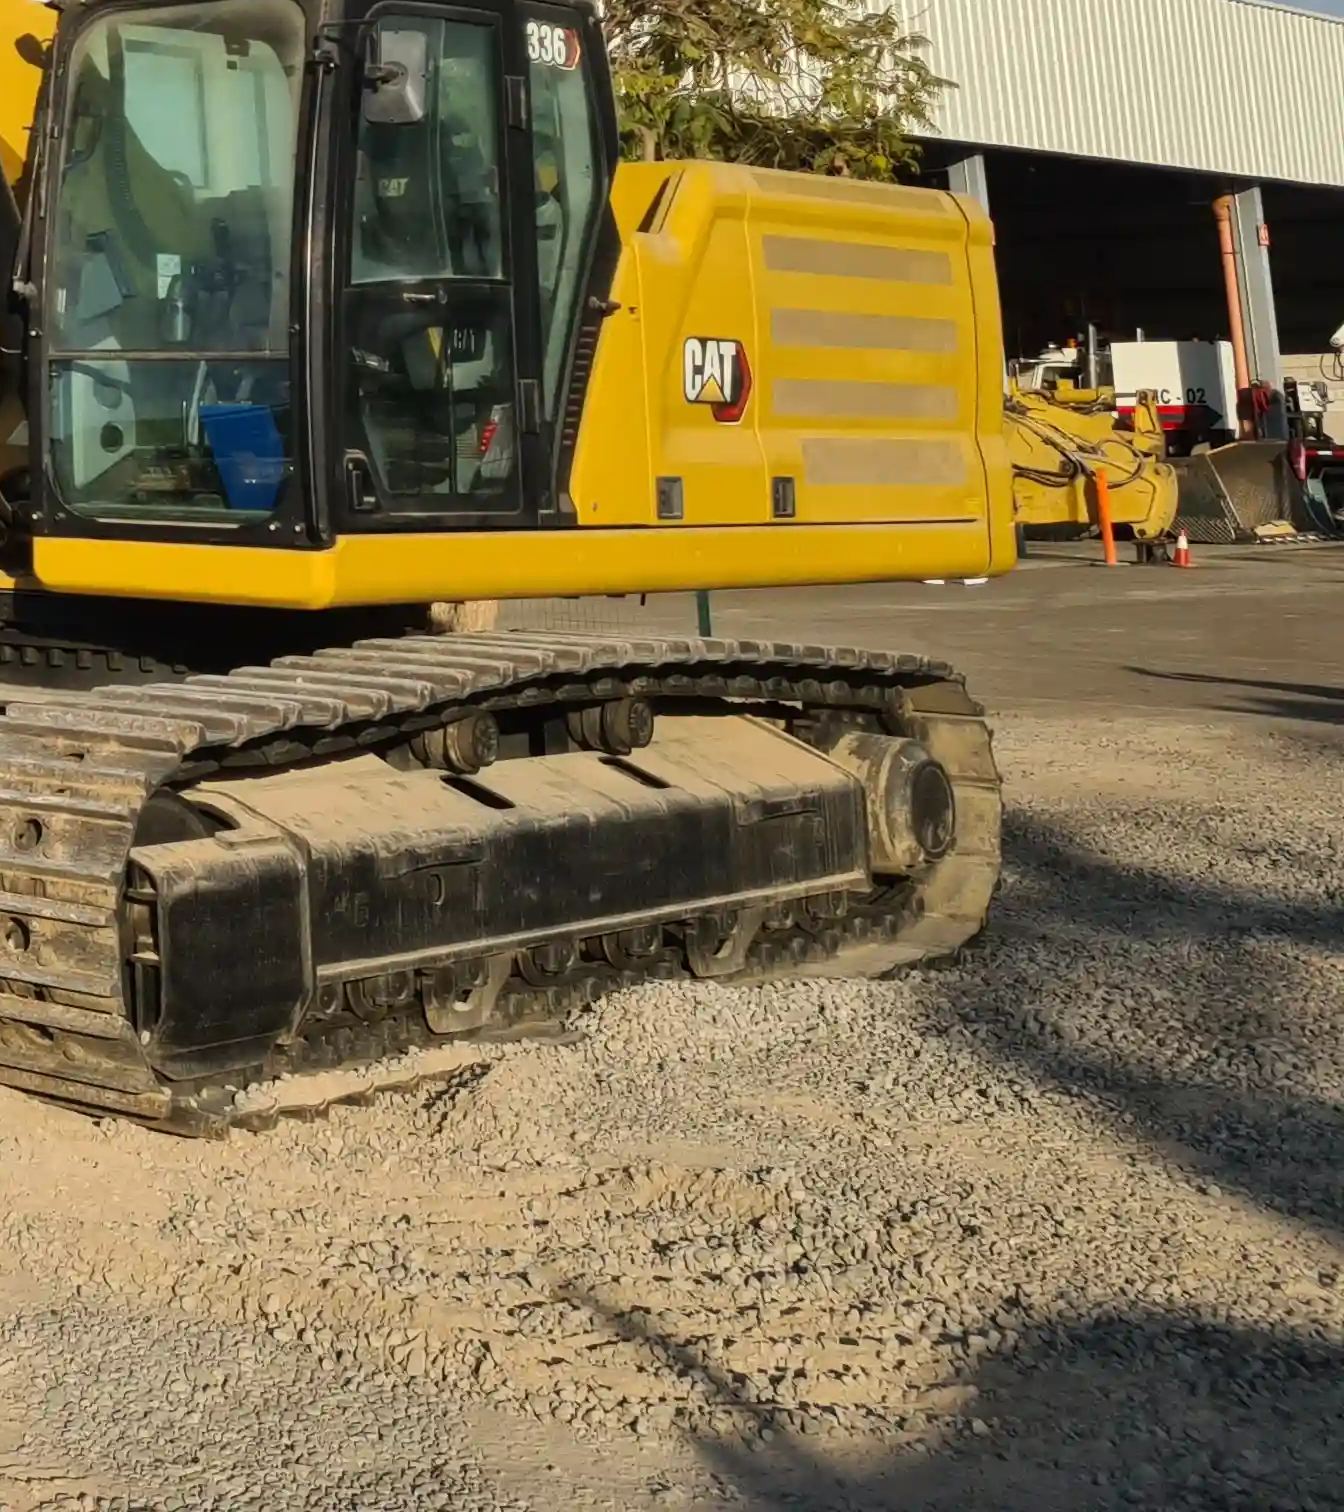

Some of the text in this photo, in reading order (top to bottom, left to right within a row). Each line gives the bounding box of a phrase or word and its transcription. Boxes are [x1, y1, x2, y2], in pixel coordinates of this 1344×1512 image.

[526, 21, 567, 66] 336
[378, 178, 410, 197] CAT
[684, 338, 737, 404] CAT
[1186, 388, 1207, 405] 02
